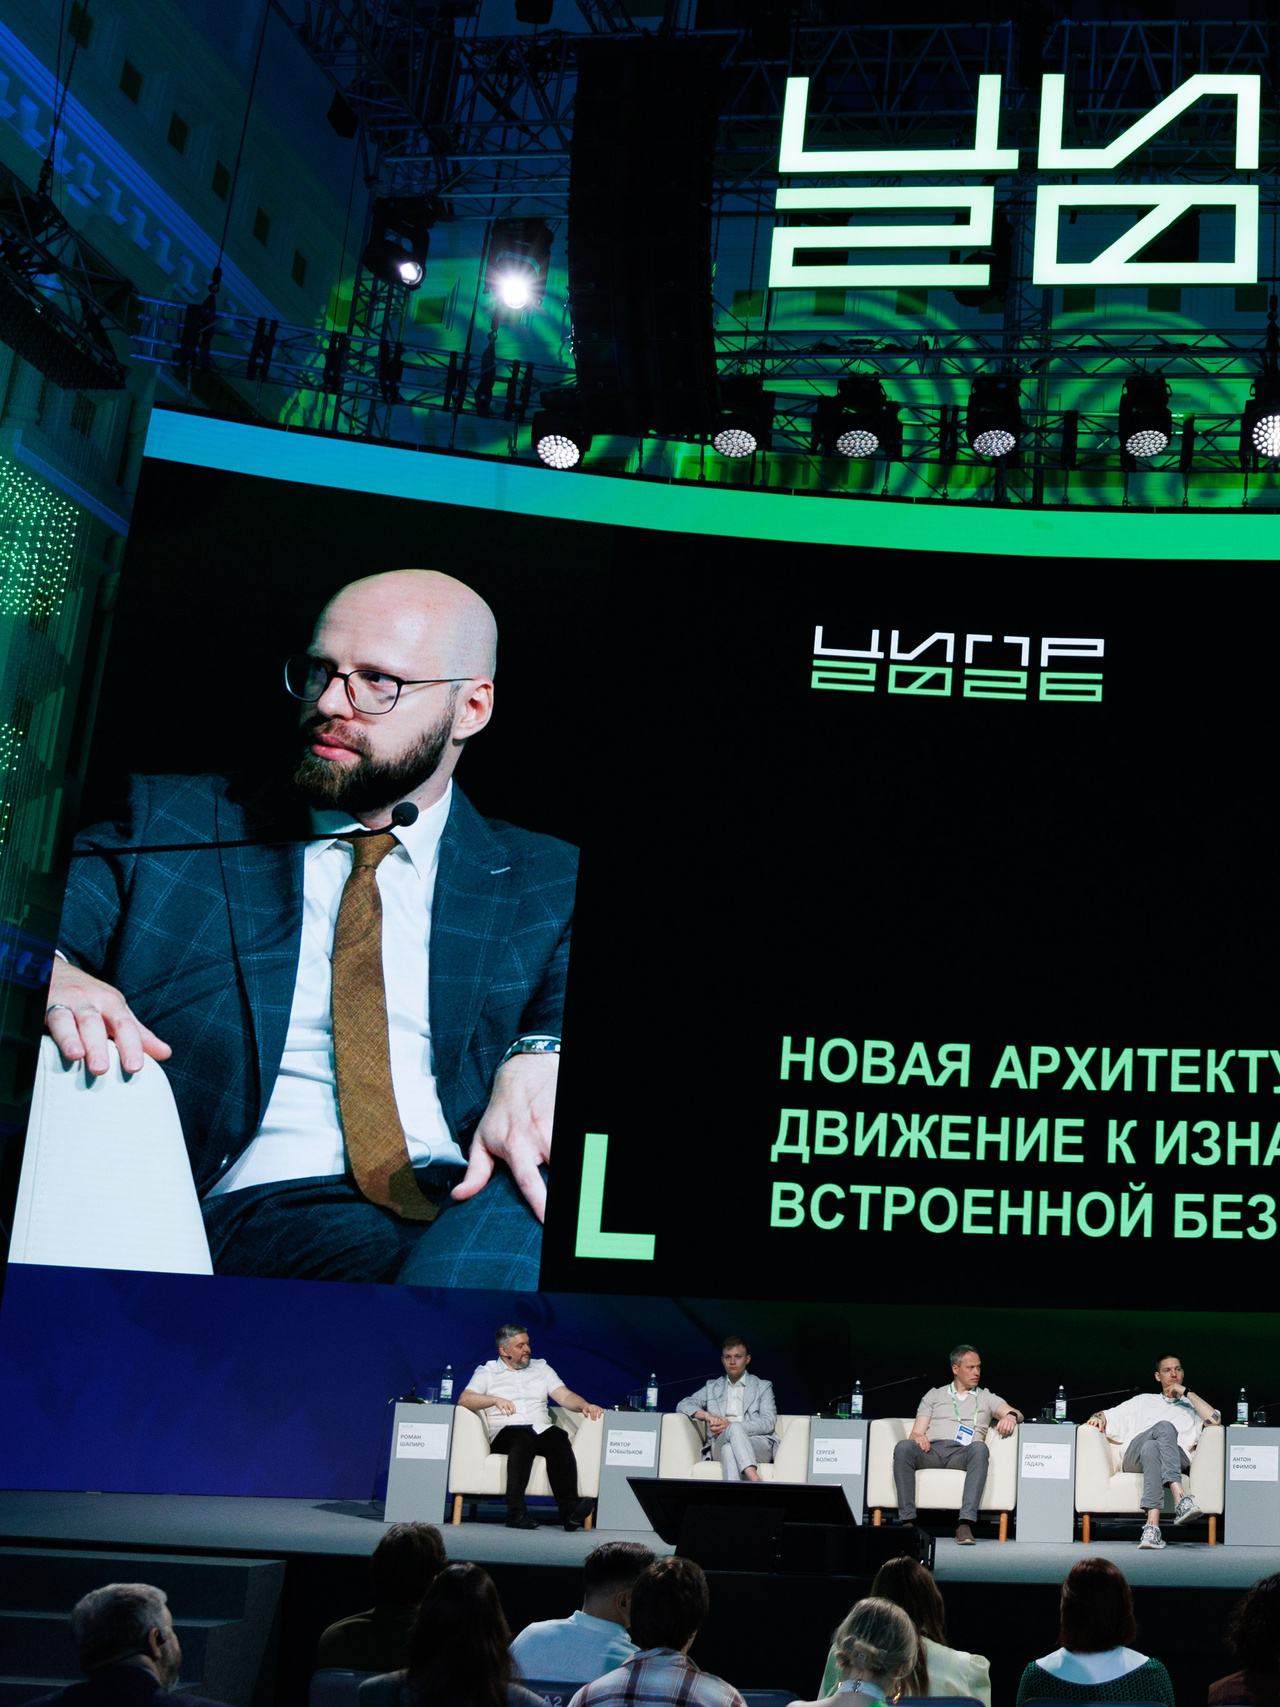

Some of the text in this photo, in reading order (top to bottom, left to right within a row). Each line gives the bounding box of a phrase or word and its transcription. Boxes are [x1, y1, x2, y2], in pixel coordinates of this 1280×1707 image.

[810, 659, 1104, 703] 2026
[779, 1035, 971, 1088] НОВАЯ
[770, 1108, 1085, 1164] ДВИЖЕНИЕ
[1107, 1119, 1138, 1165] К
[769, 1181, 1153, 1238] ВСТРОЕННОЙ
